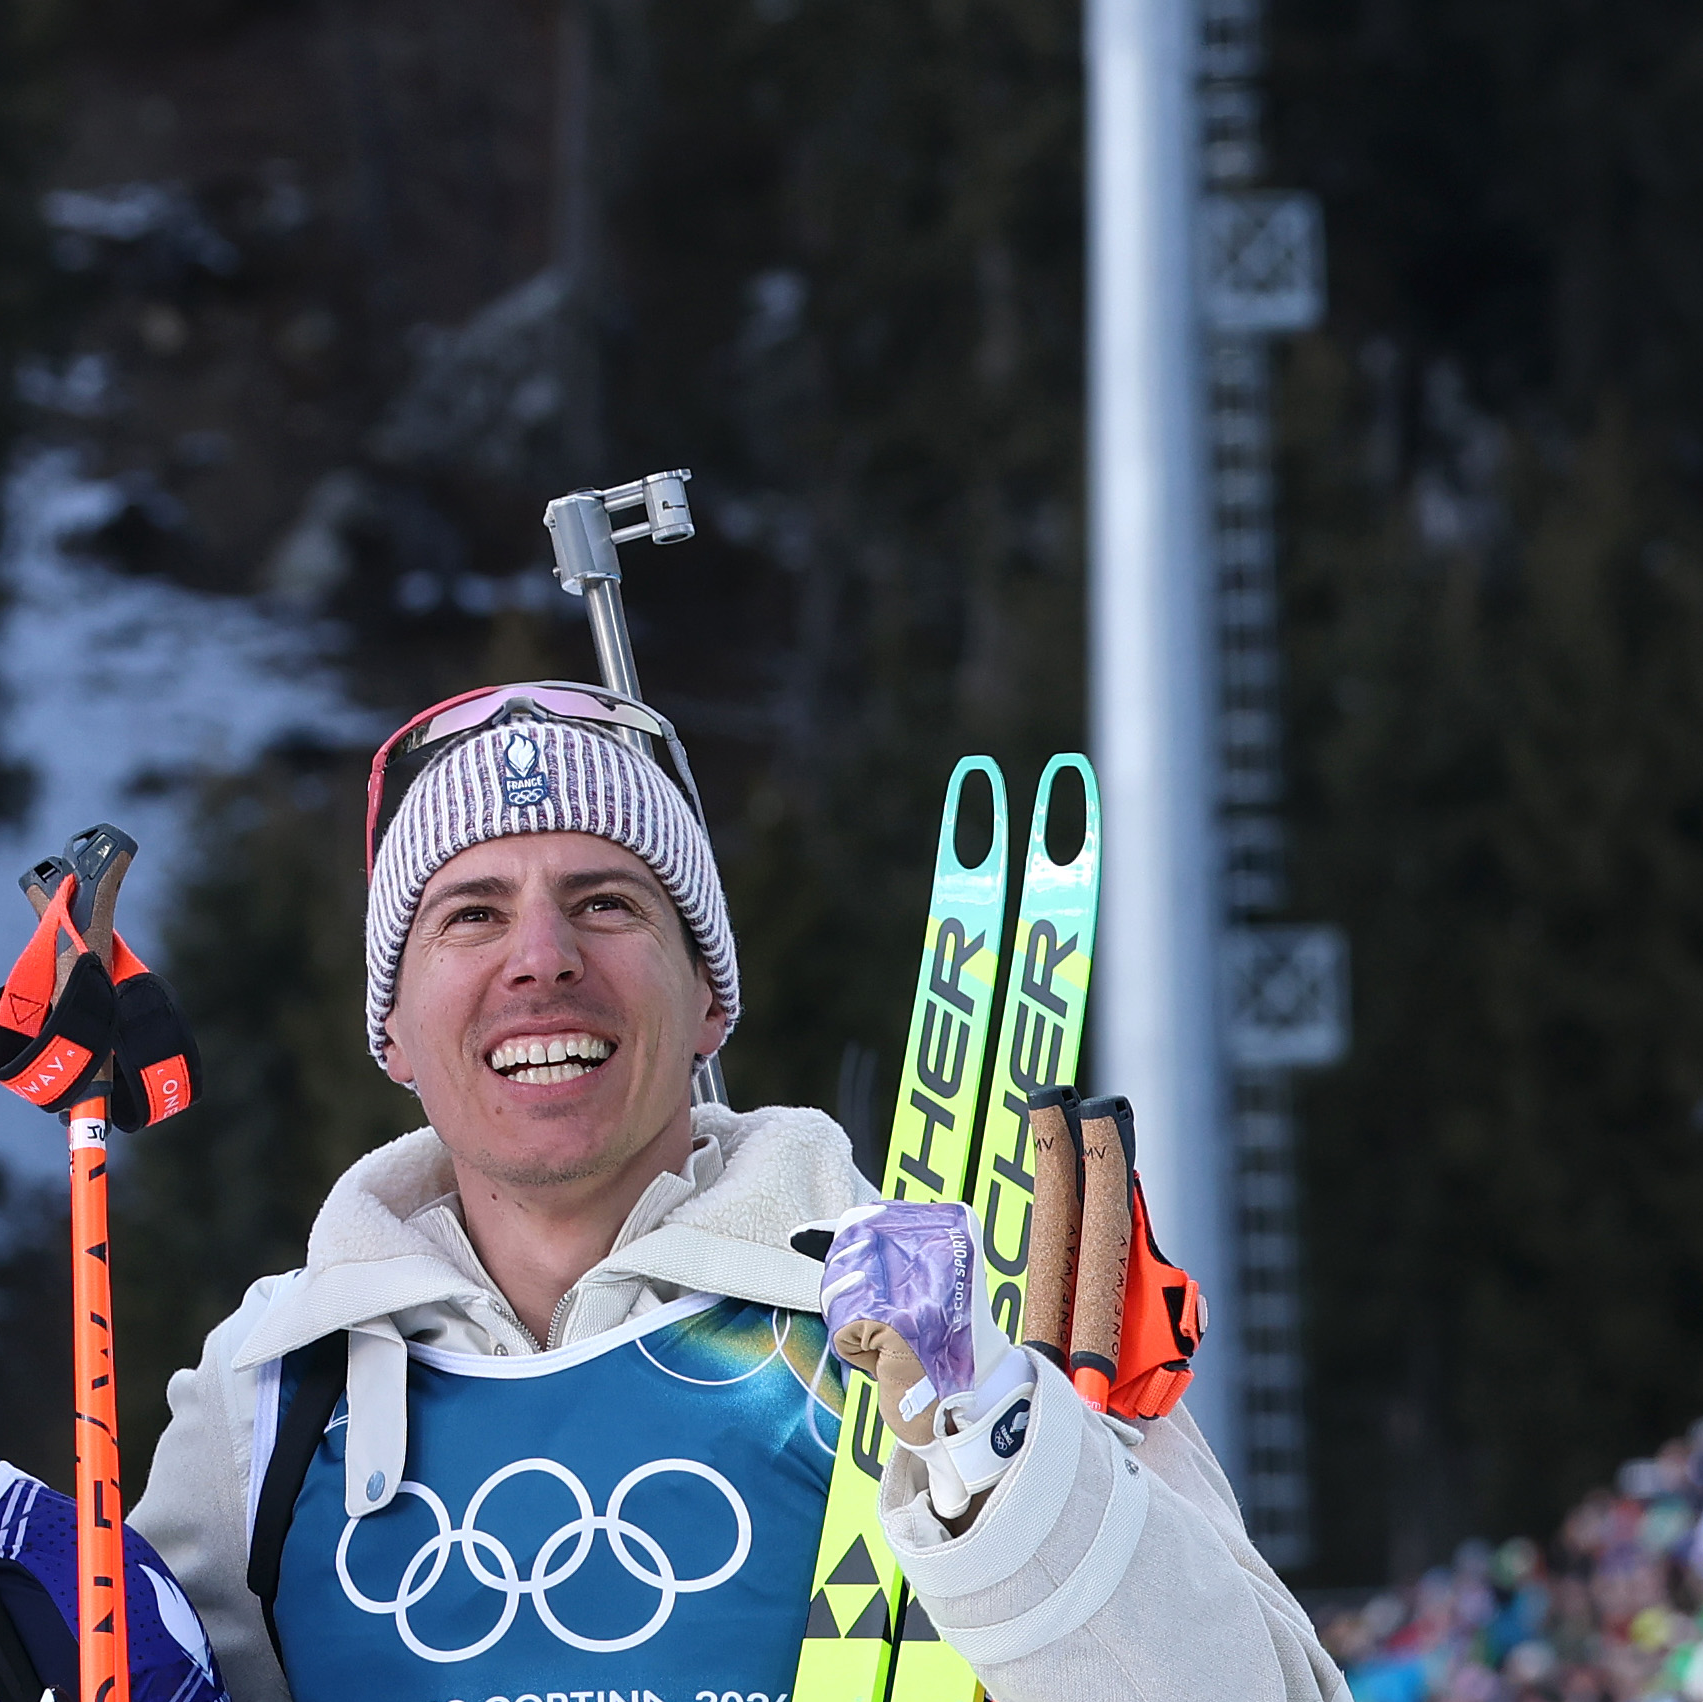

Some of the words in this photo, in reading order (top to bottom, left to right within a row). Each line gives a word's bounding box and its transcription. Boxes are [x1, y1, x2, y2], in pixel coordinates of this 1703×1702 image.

[506, 776, 544, 791] FRANCE
[983, 919, 1079, 1345] SCHER
[852, 917, 986, 1481] FHER
[954, 1282, 965, 1315] COQ
[953, 1317, 962, 1333] LE
